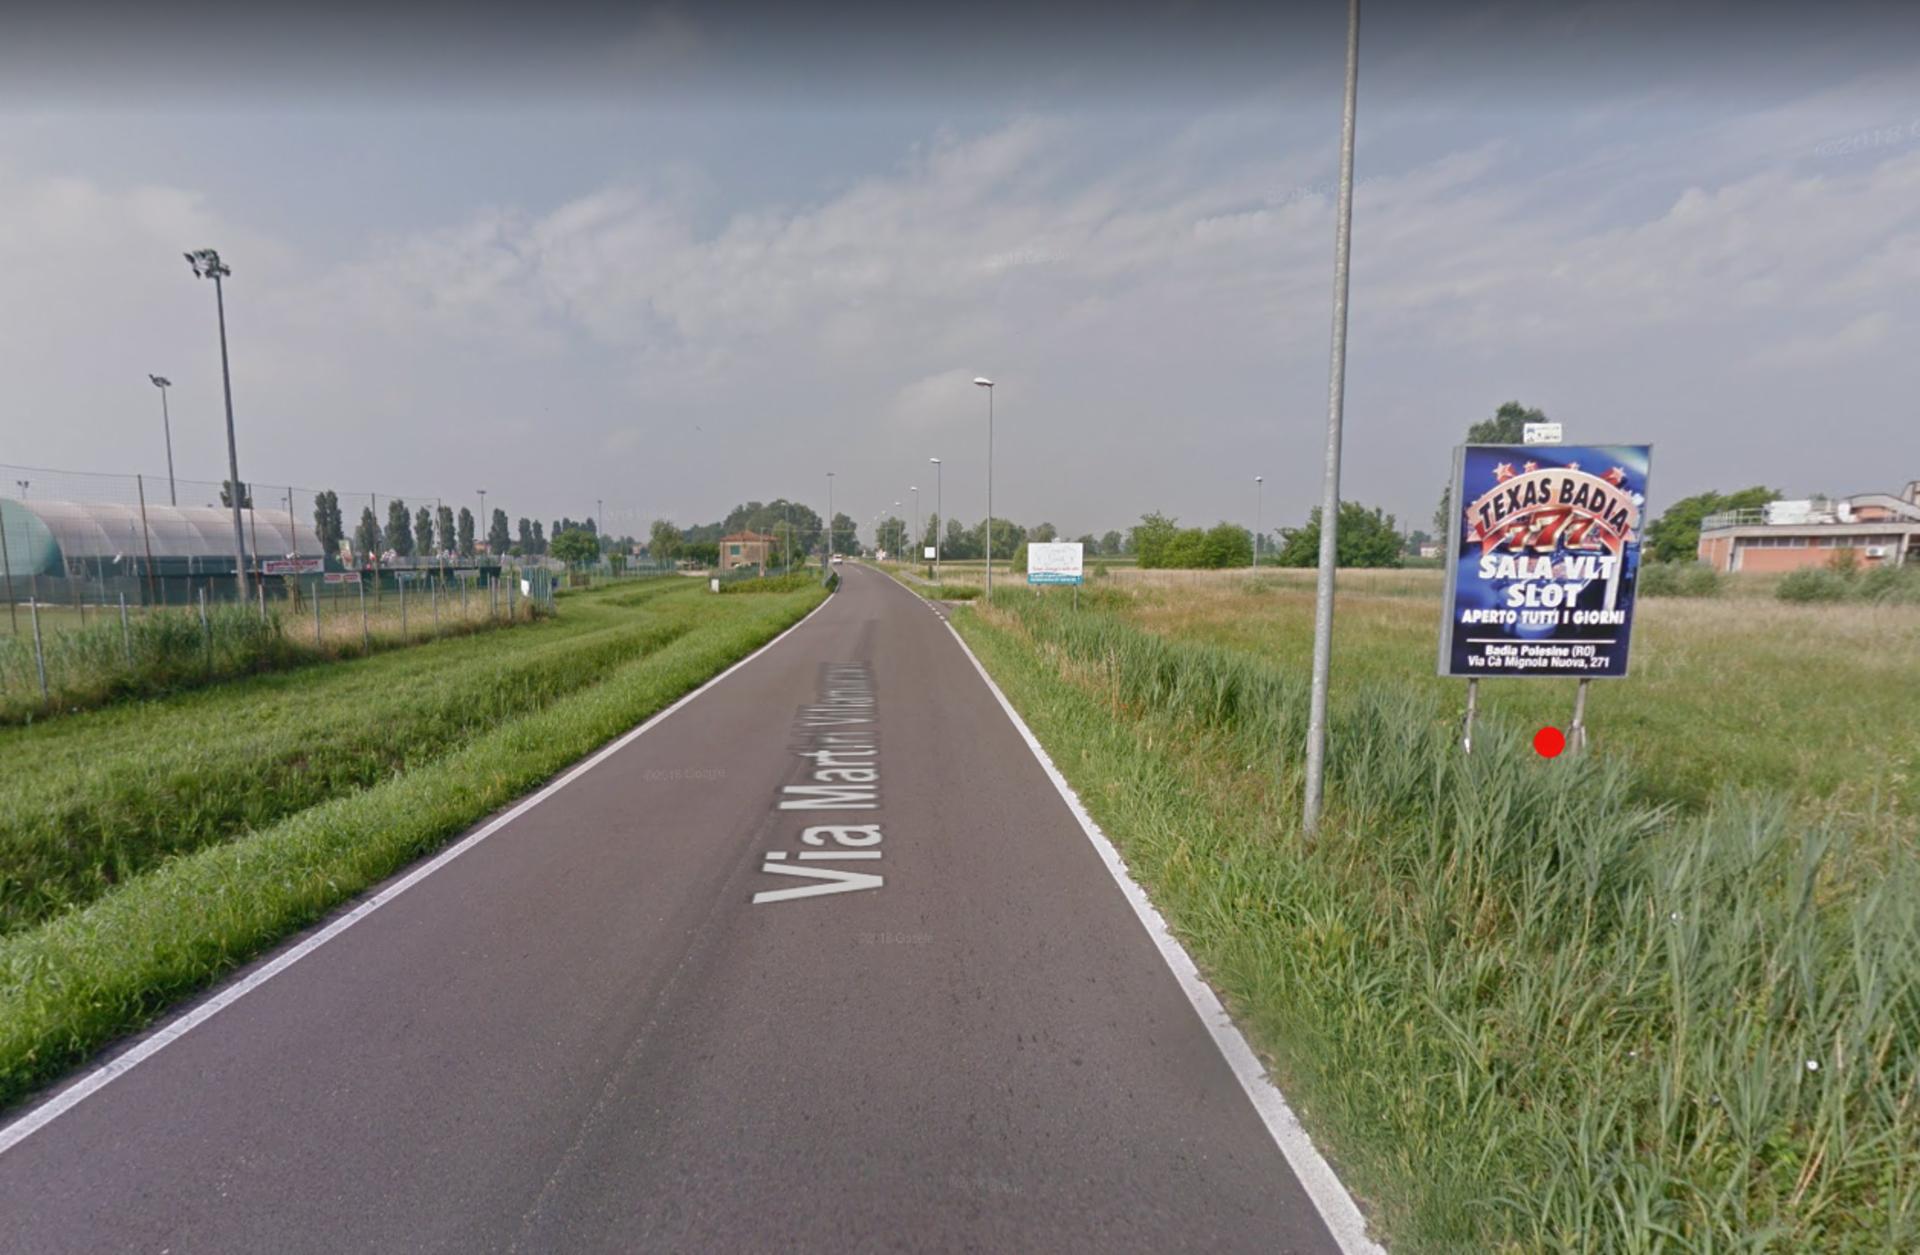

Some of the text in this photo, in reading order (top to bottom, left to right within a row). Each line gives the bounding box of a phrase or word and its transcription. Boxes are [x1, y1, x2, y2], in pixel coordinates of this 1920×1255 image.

[1479, 478, 1629, 532] TEXAS BADIA
[1478, 556, 1616, 579] SALA VLT
[1506, 583, 1582, 607] SLOT
[1461, 609, 1626, 625] APERTO TUTTI I GIORNI
[1485, 644, 1596, 658] Badia Polesine (RO)
[1468, 655, 1485, 667] Via
[1503, 656, 1549, 669] Mignola
[1551, 657, 1589, 669] Nuova,
[1590, 657, 1610, 668] 271
